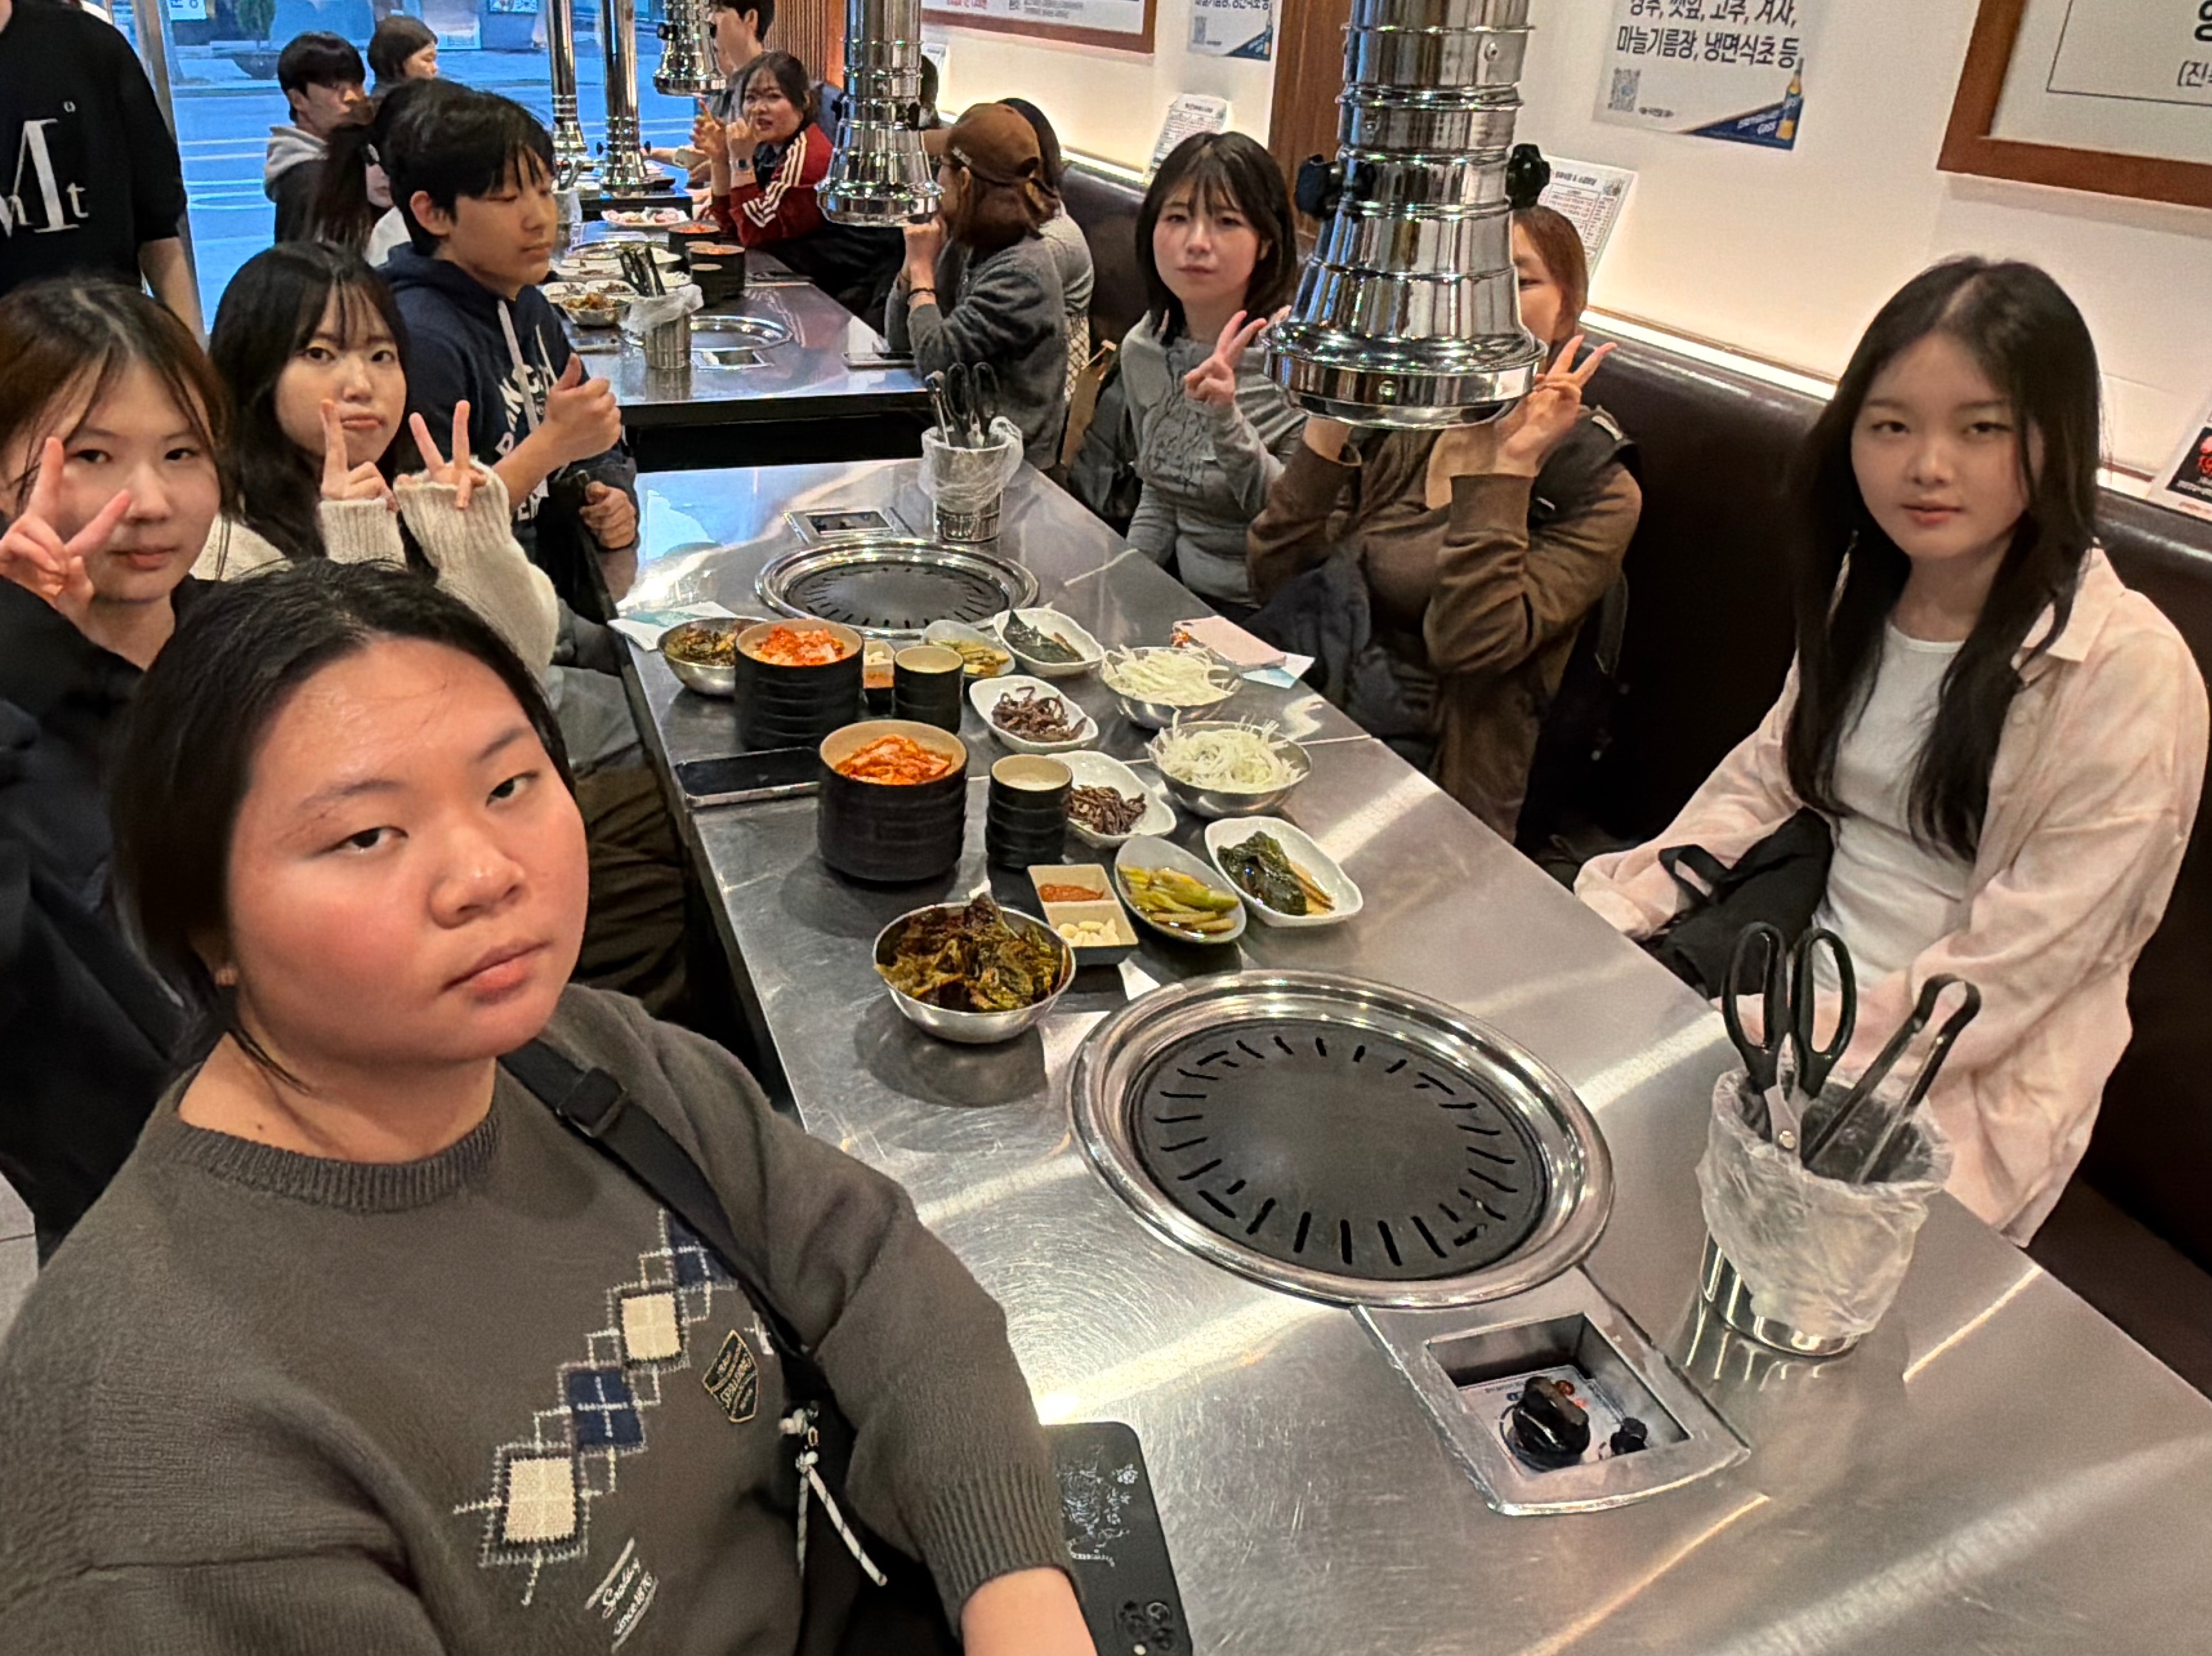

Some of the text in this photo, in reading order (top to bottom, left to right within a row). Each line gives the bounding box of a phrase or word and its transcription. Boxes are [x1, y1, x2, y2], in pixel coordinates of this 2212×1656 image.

[1616, 25, 1800, 69] 마늘기름장, 냉면식초 등
